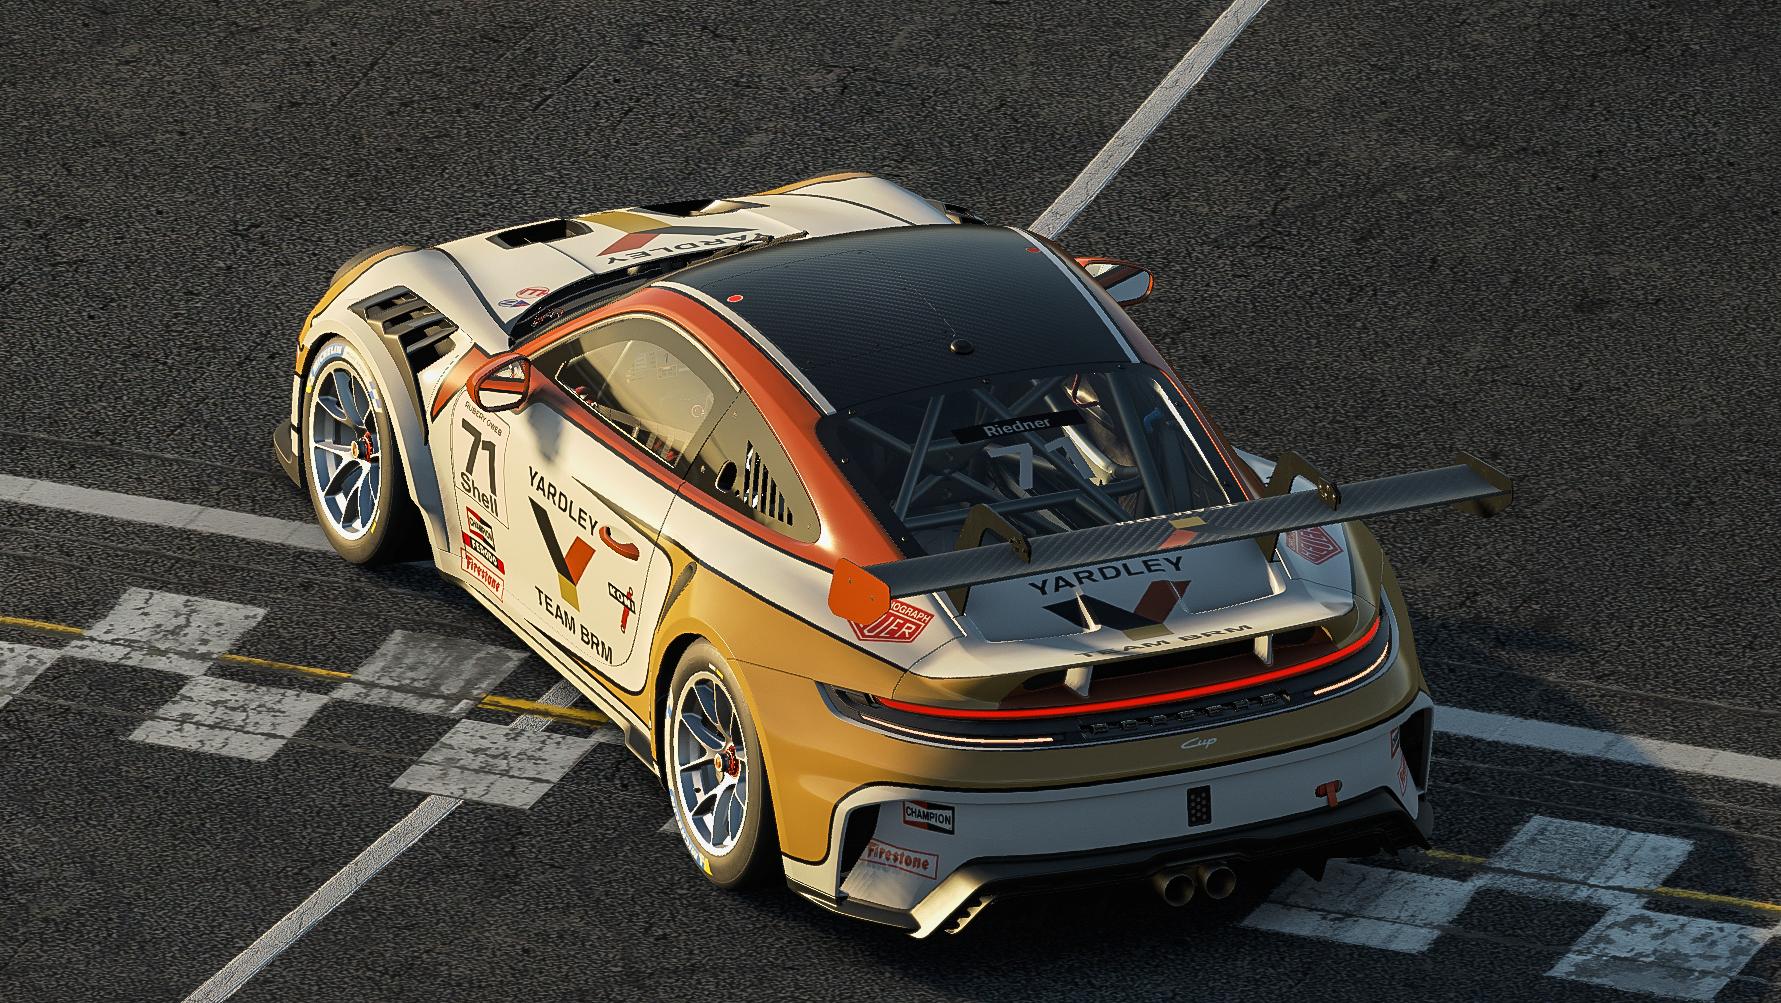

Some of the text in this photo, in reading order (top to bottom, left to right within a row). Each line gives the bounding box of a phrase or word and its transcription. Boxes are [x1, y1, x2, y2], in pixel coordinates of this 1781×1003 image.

[464, 400, 487, 423] RUBERY
[983, 418, 1051, 437] Riedner
[461, 417, 497, 498] 71
[983, 436, 1096, 489] 71
[460, 471, 499, 517] Shell
[528, 465, 599, 537] YARDLEY
[465, 554, 500, 593] Firestone
[1028, 555, 1184, 597] YARDLEY
[534, 585, 614, 665] TEAM BRM
[1073, 624, 1254, 659] TEAM BRM
[1180, 736, 1218, 751] Cup
[905, 805, 952, 826] CHAMPION
[866, 841, 930, 870] Firestone
